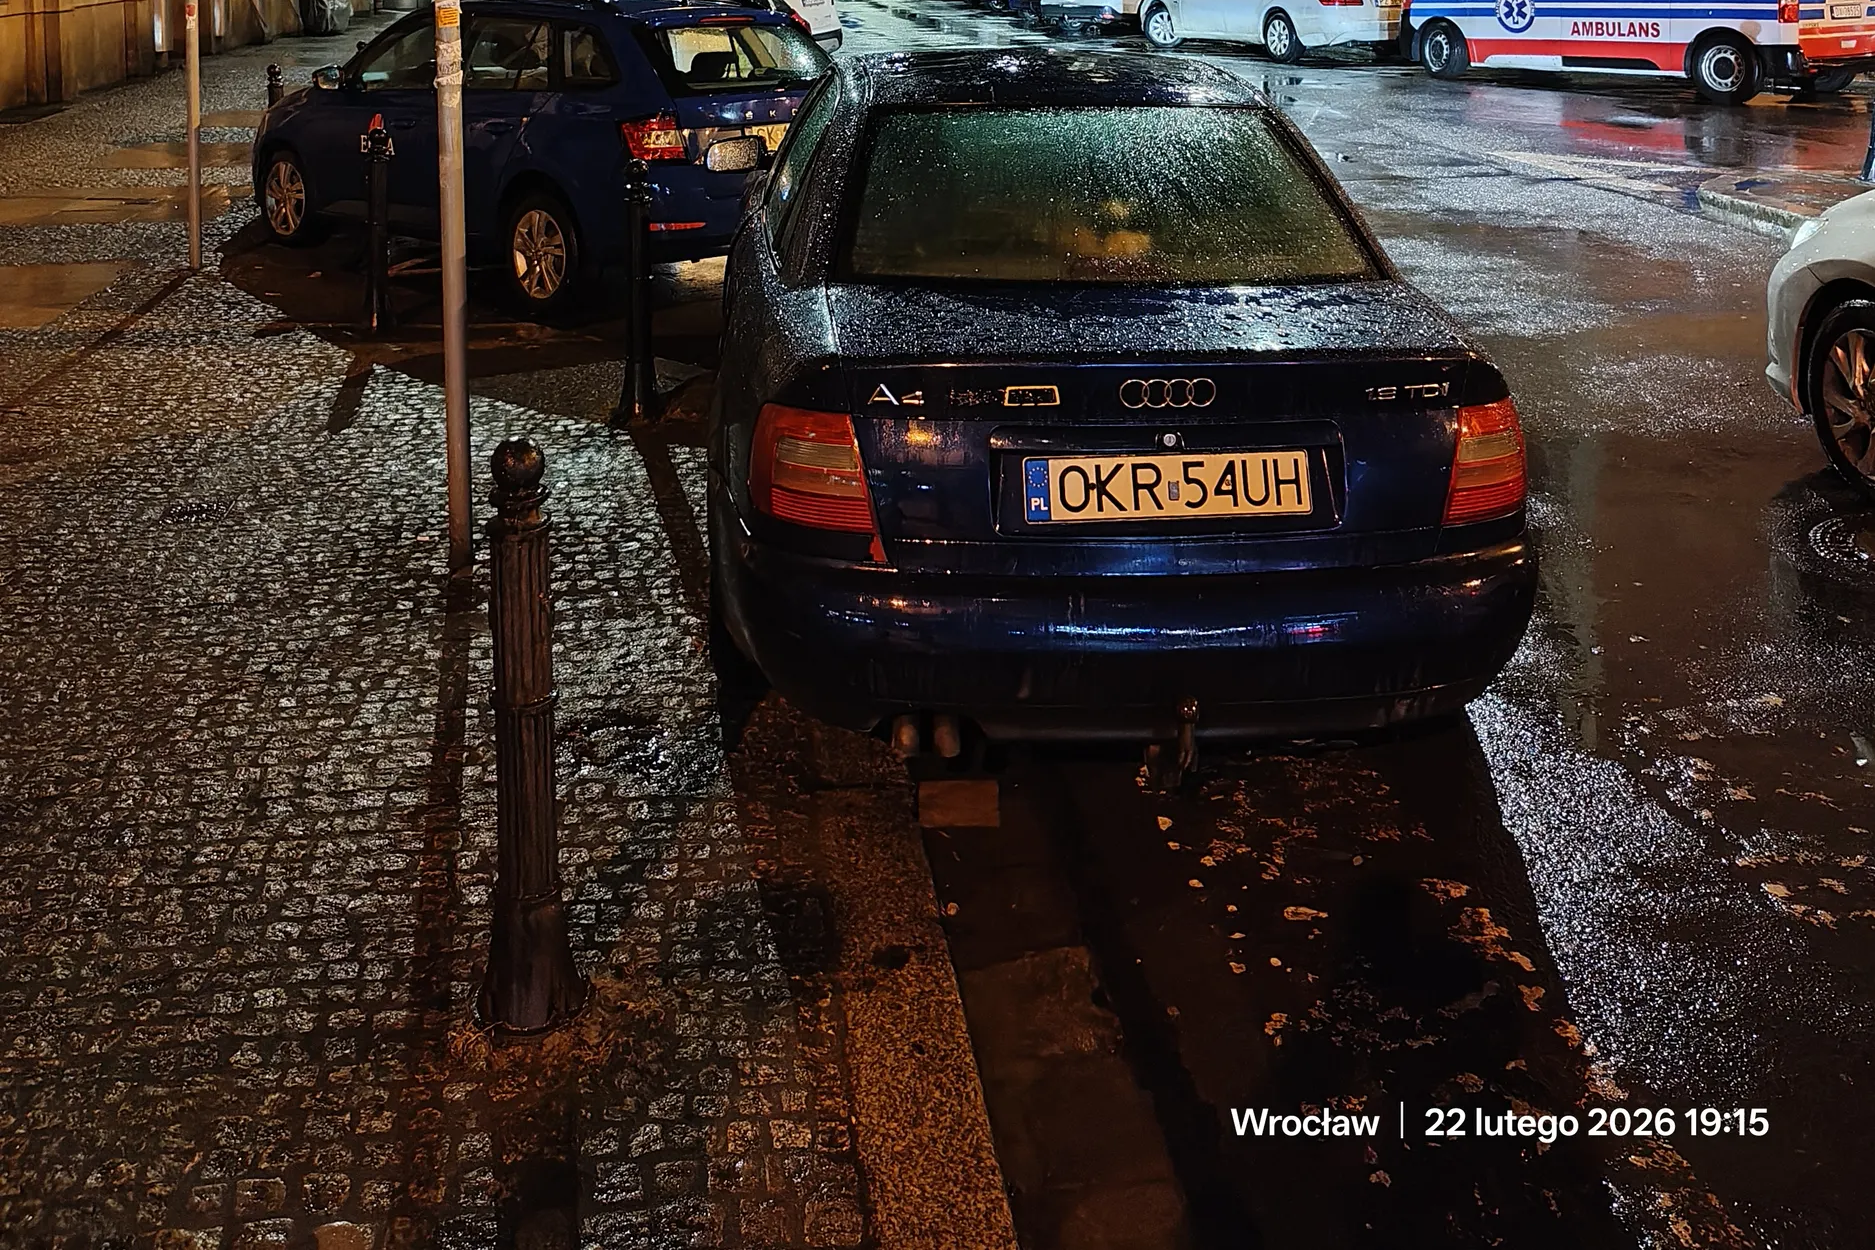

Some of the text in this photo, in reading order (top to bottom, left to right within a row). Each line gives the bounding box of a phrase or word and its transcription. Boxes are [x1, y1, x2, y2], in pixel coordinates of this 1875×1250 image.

[1570, 21, 1661, 38] AMBULANS
[1030, 458, 1303, 513] PL OKR 54UH
